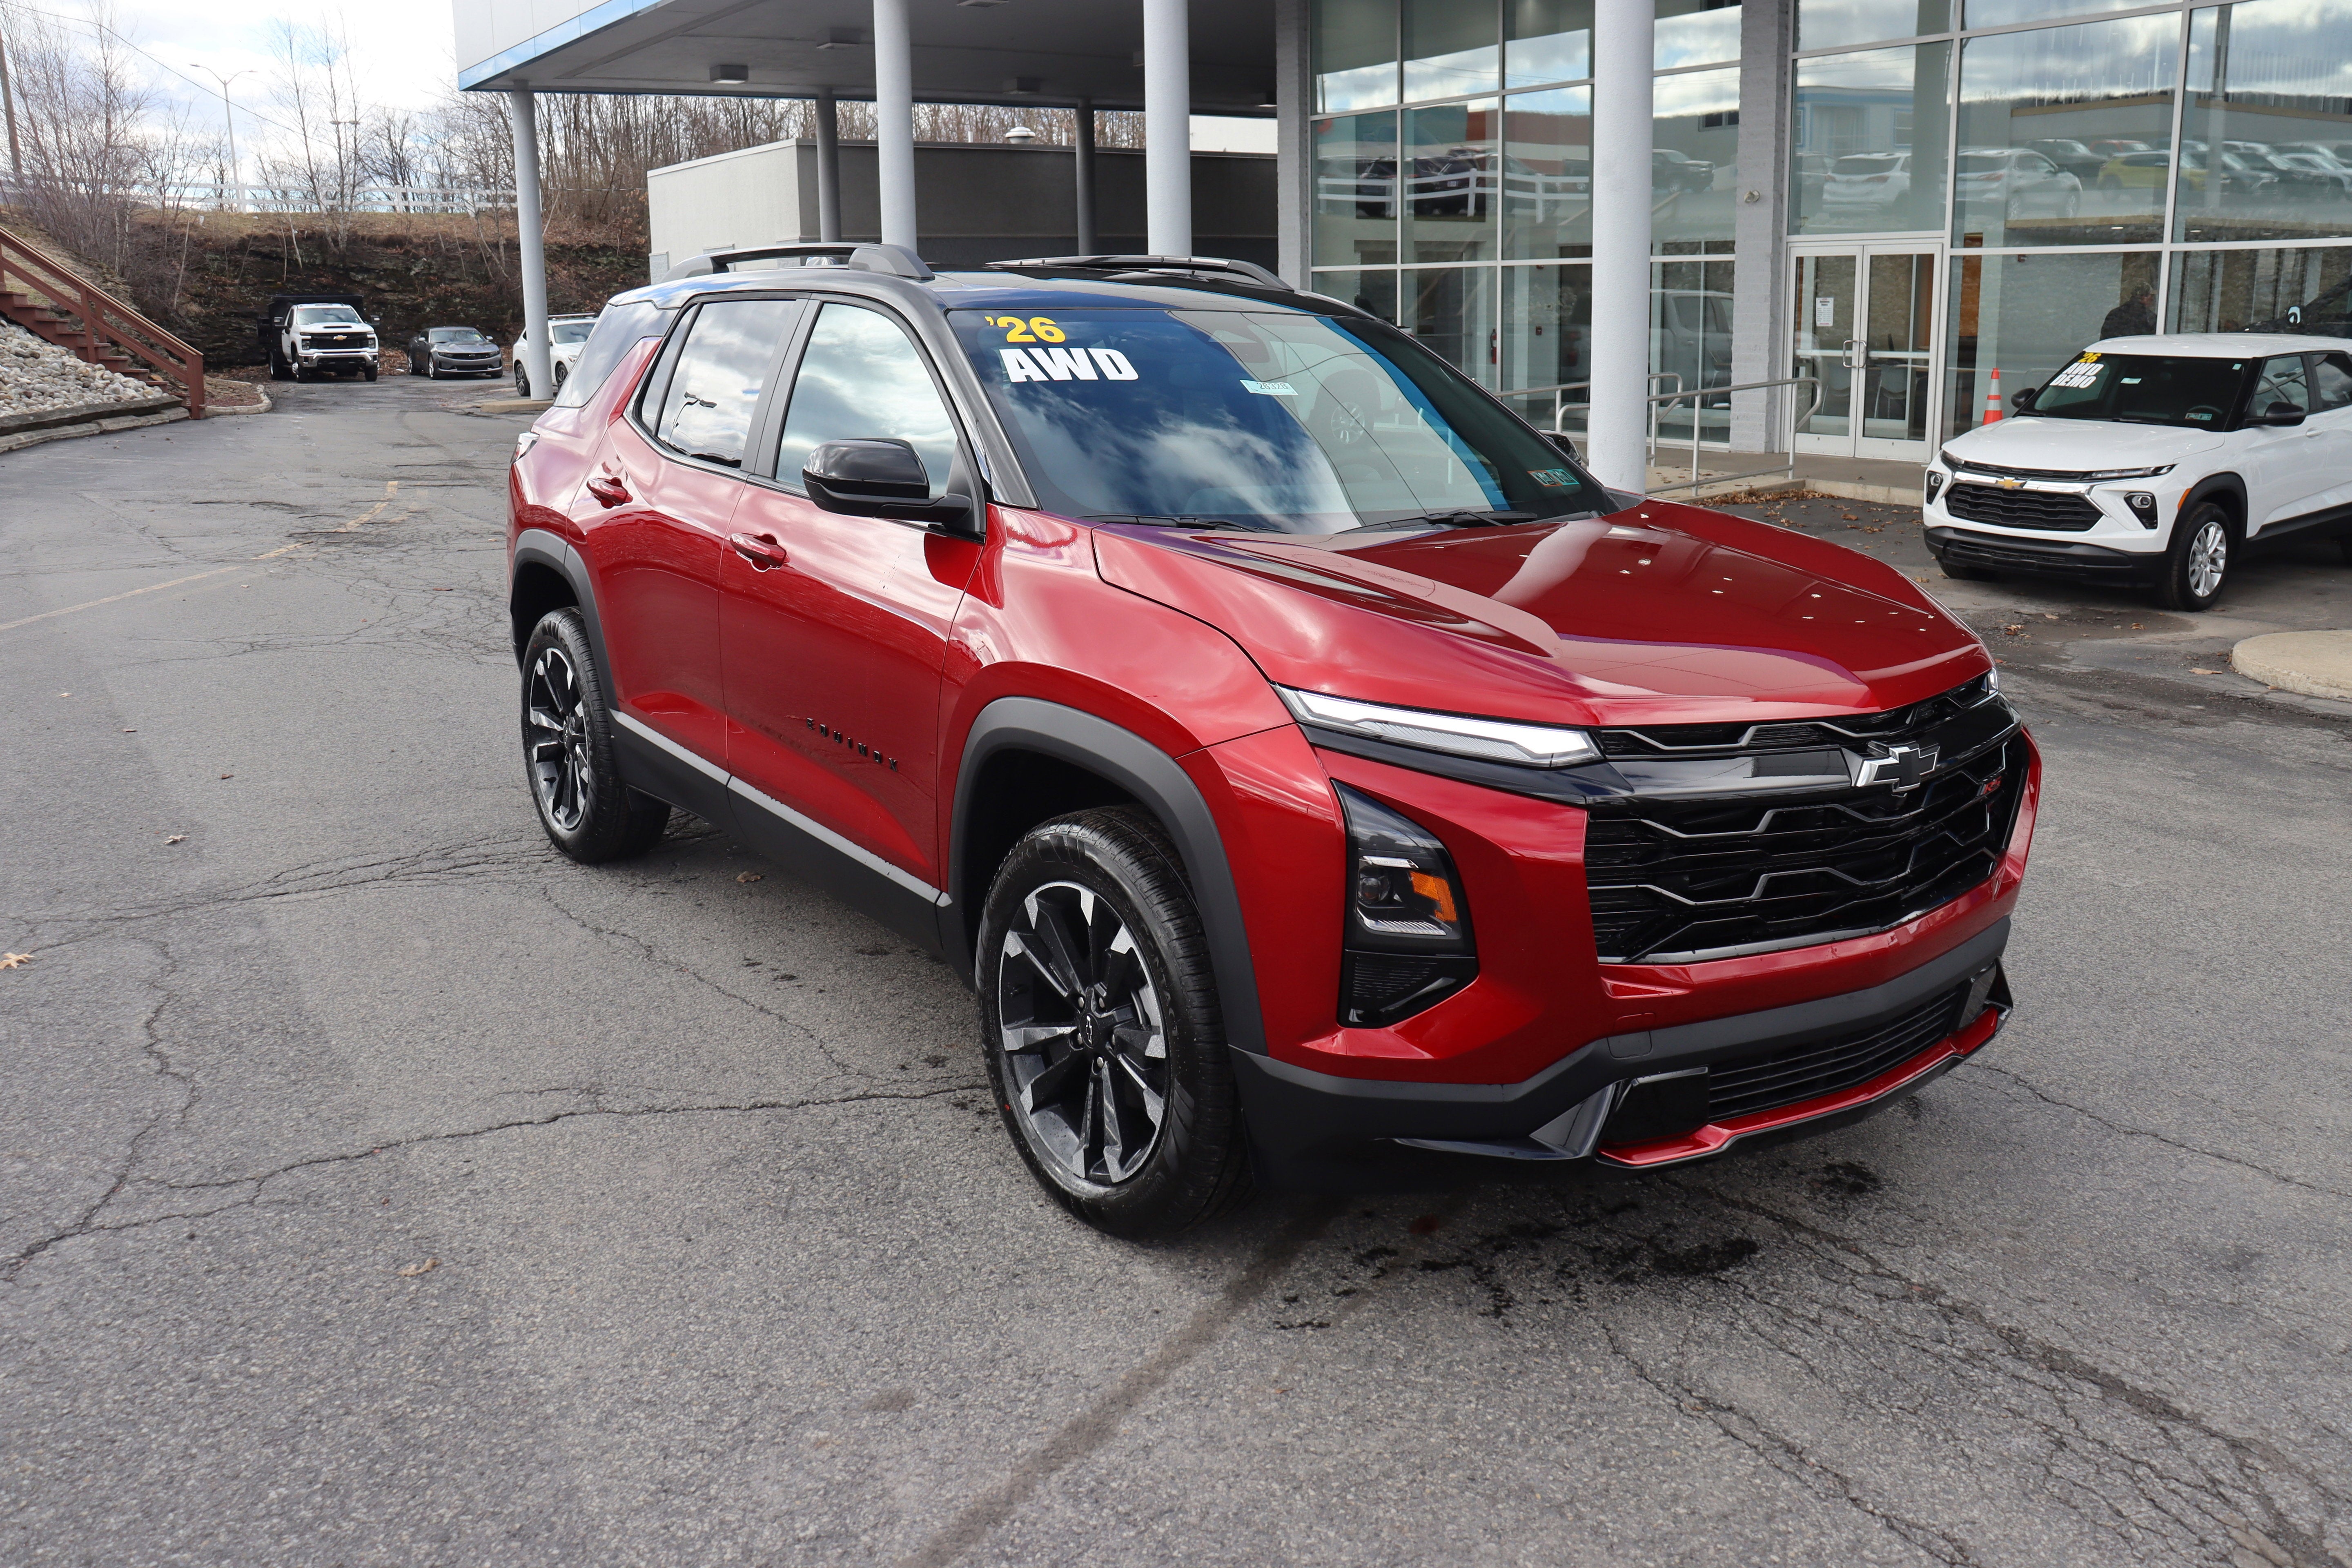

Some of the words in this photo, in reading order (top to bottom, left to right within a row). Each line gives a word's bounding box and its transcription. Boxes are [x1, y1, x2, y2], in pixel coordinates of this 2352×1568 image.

[999, 348, 1139, 383] AWD
[2061, 362, 2104, 376] AWD
[2049, 374, 2096, 388] DEMO
